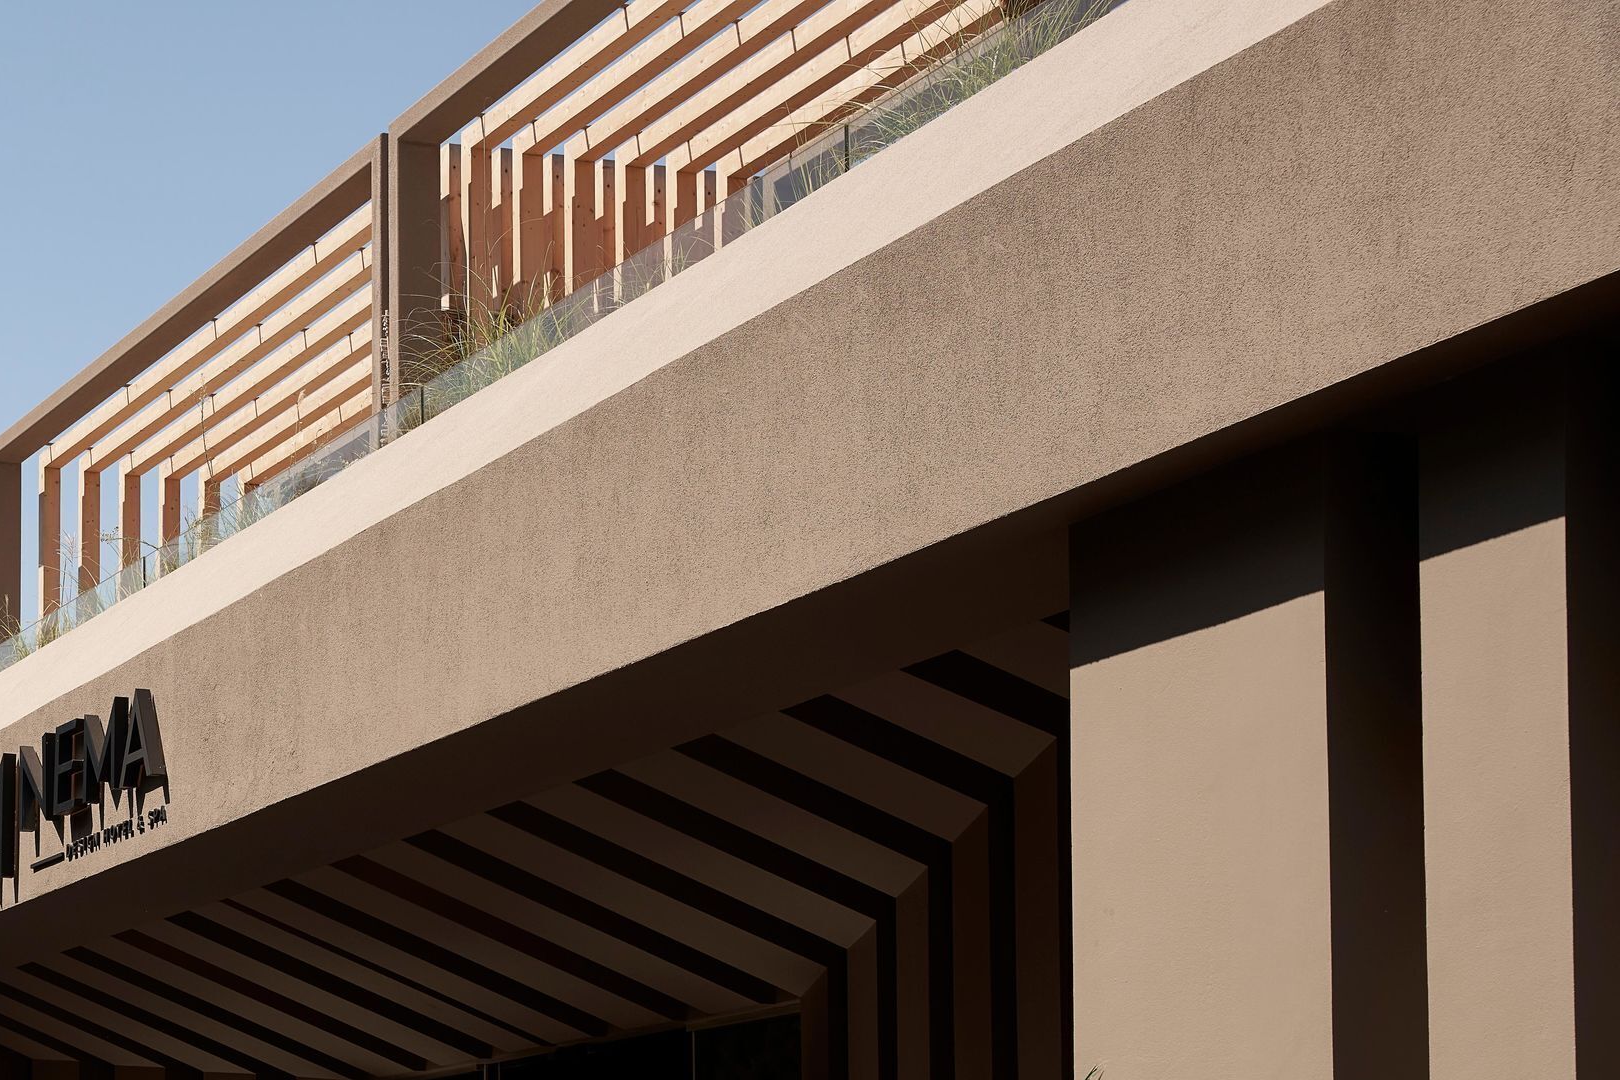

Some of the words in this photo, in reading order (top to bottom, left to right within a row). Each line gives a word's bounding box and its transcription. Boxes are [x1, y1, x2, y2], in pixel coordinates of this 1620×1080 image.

[65, 832, 101, 861] DESIGN
[103, 820, 135, 846] HOTEL
[148, 806, 168, 829] SPA
